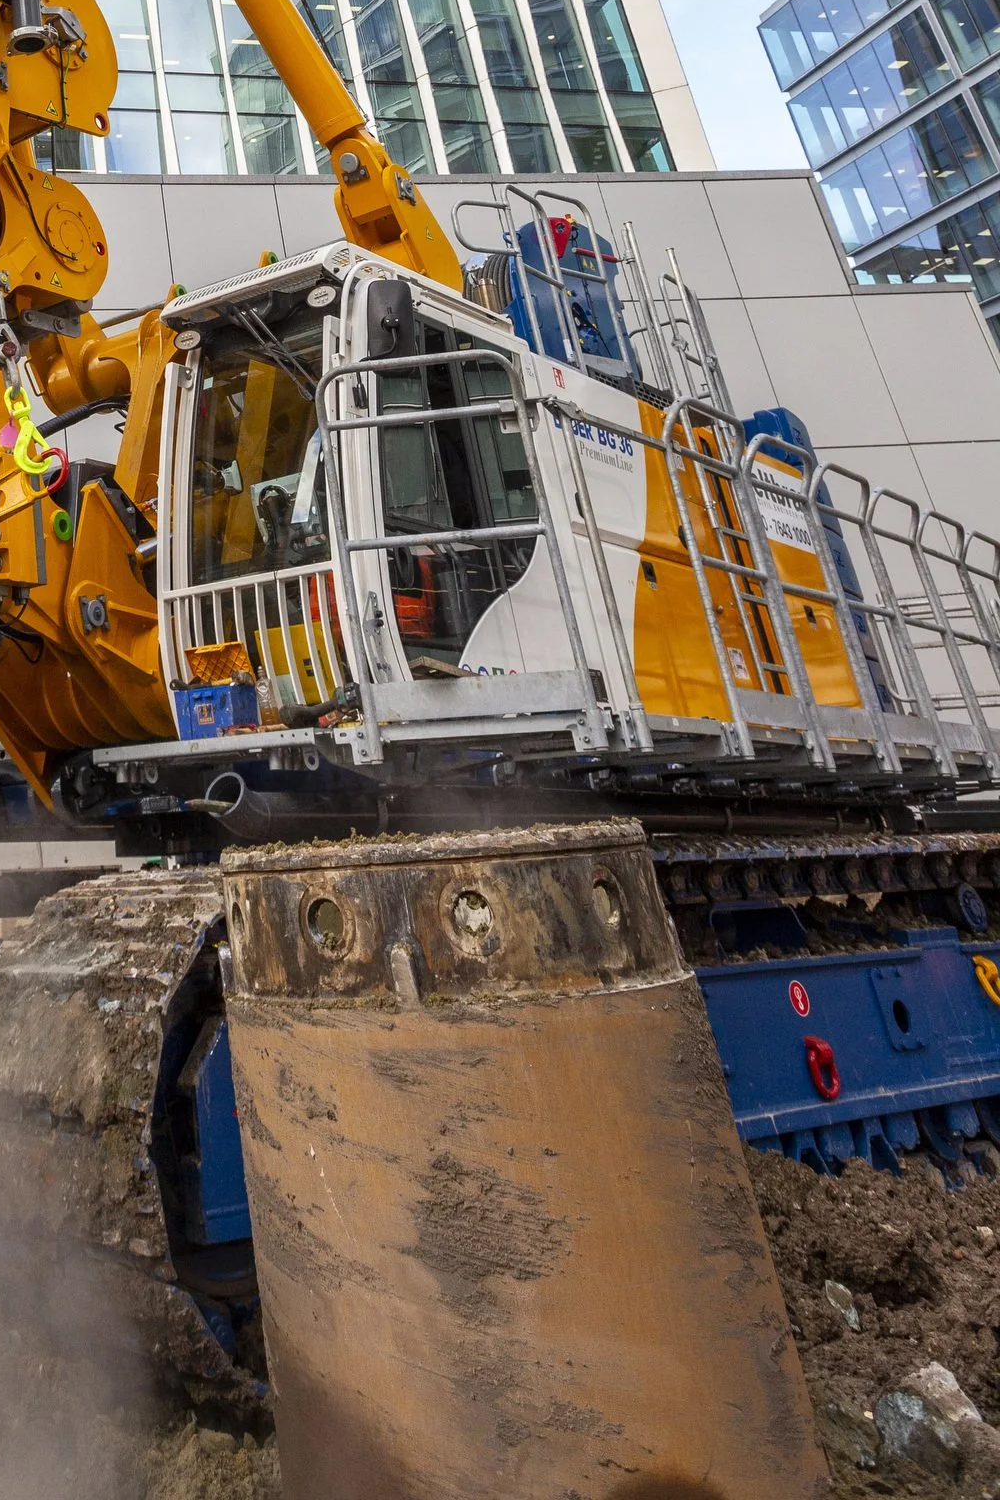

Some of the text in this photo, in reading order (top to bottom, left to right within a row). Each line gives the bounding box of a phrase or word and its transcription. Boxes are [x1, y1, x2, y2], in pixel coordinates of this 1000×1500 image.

[579, 440, 634, 473] PremiumLine
[597, 427, 617, 450] BG
[617, 435, 634, 457] 36
